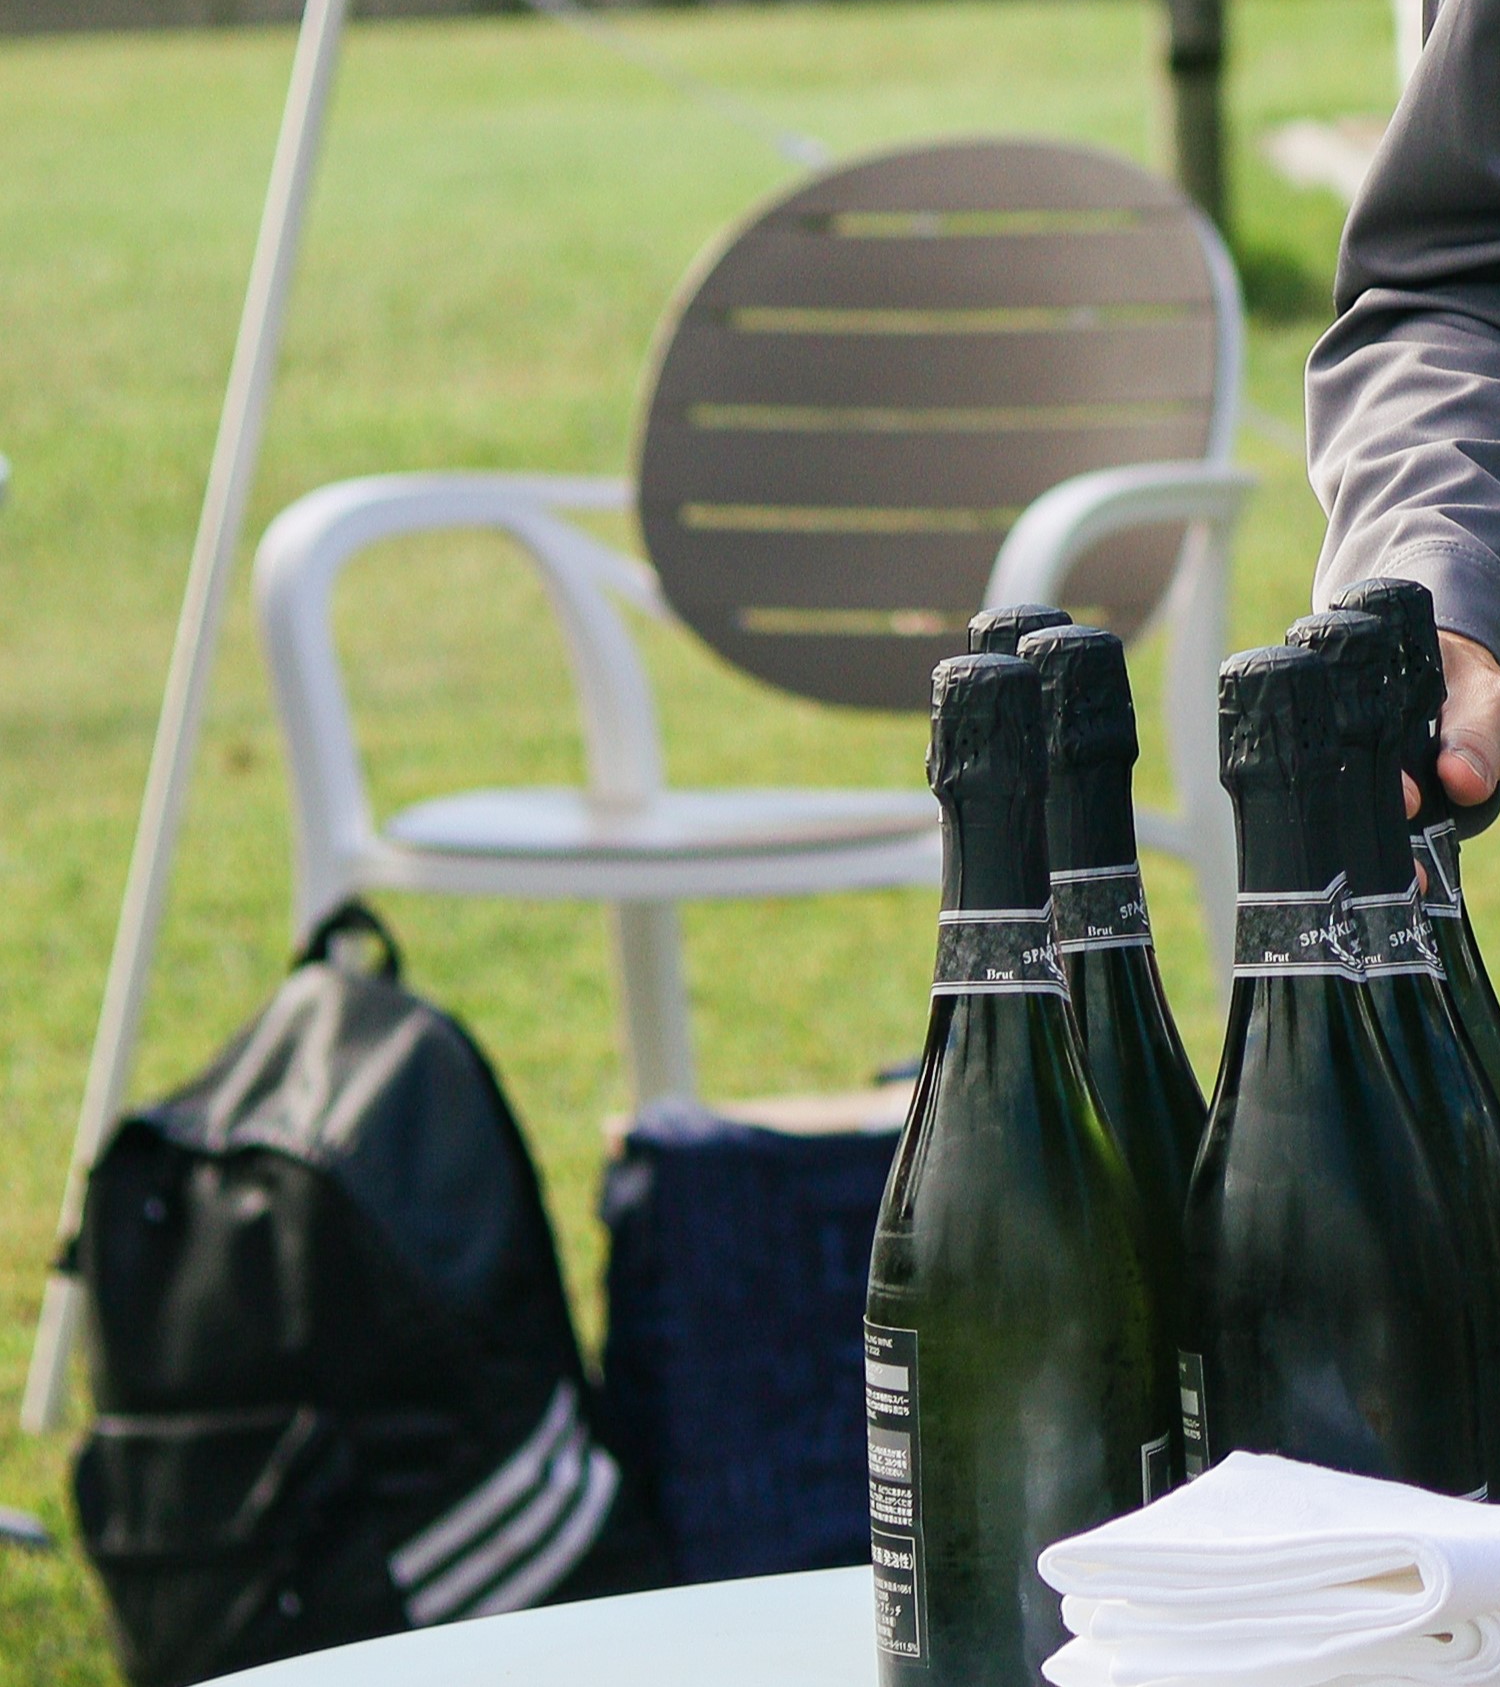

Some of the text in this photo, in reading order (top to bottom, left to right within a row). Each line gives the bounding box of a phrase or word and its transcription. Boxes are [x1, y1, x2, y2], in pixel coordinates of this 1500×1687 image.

[1087, 925, 1114, 937] Brut
[1264, 951, 1291, 963] Brut
[1361, 953, 1383, 965] rut
[986, 968, 1015, 981] Brut
